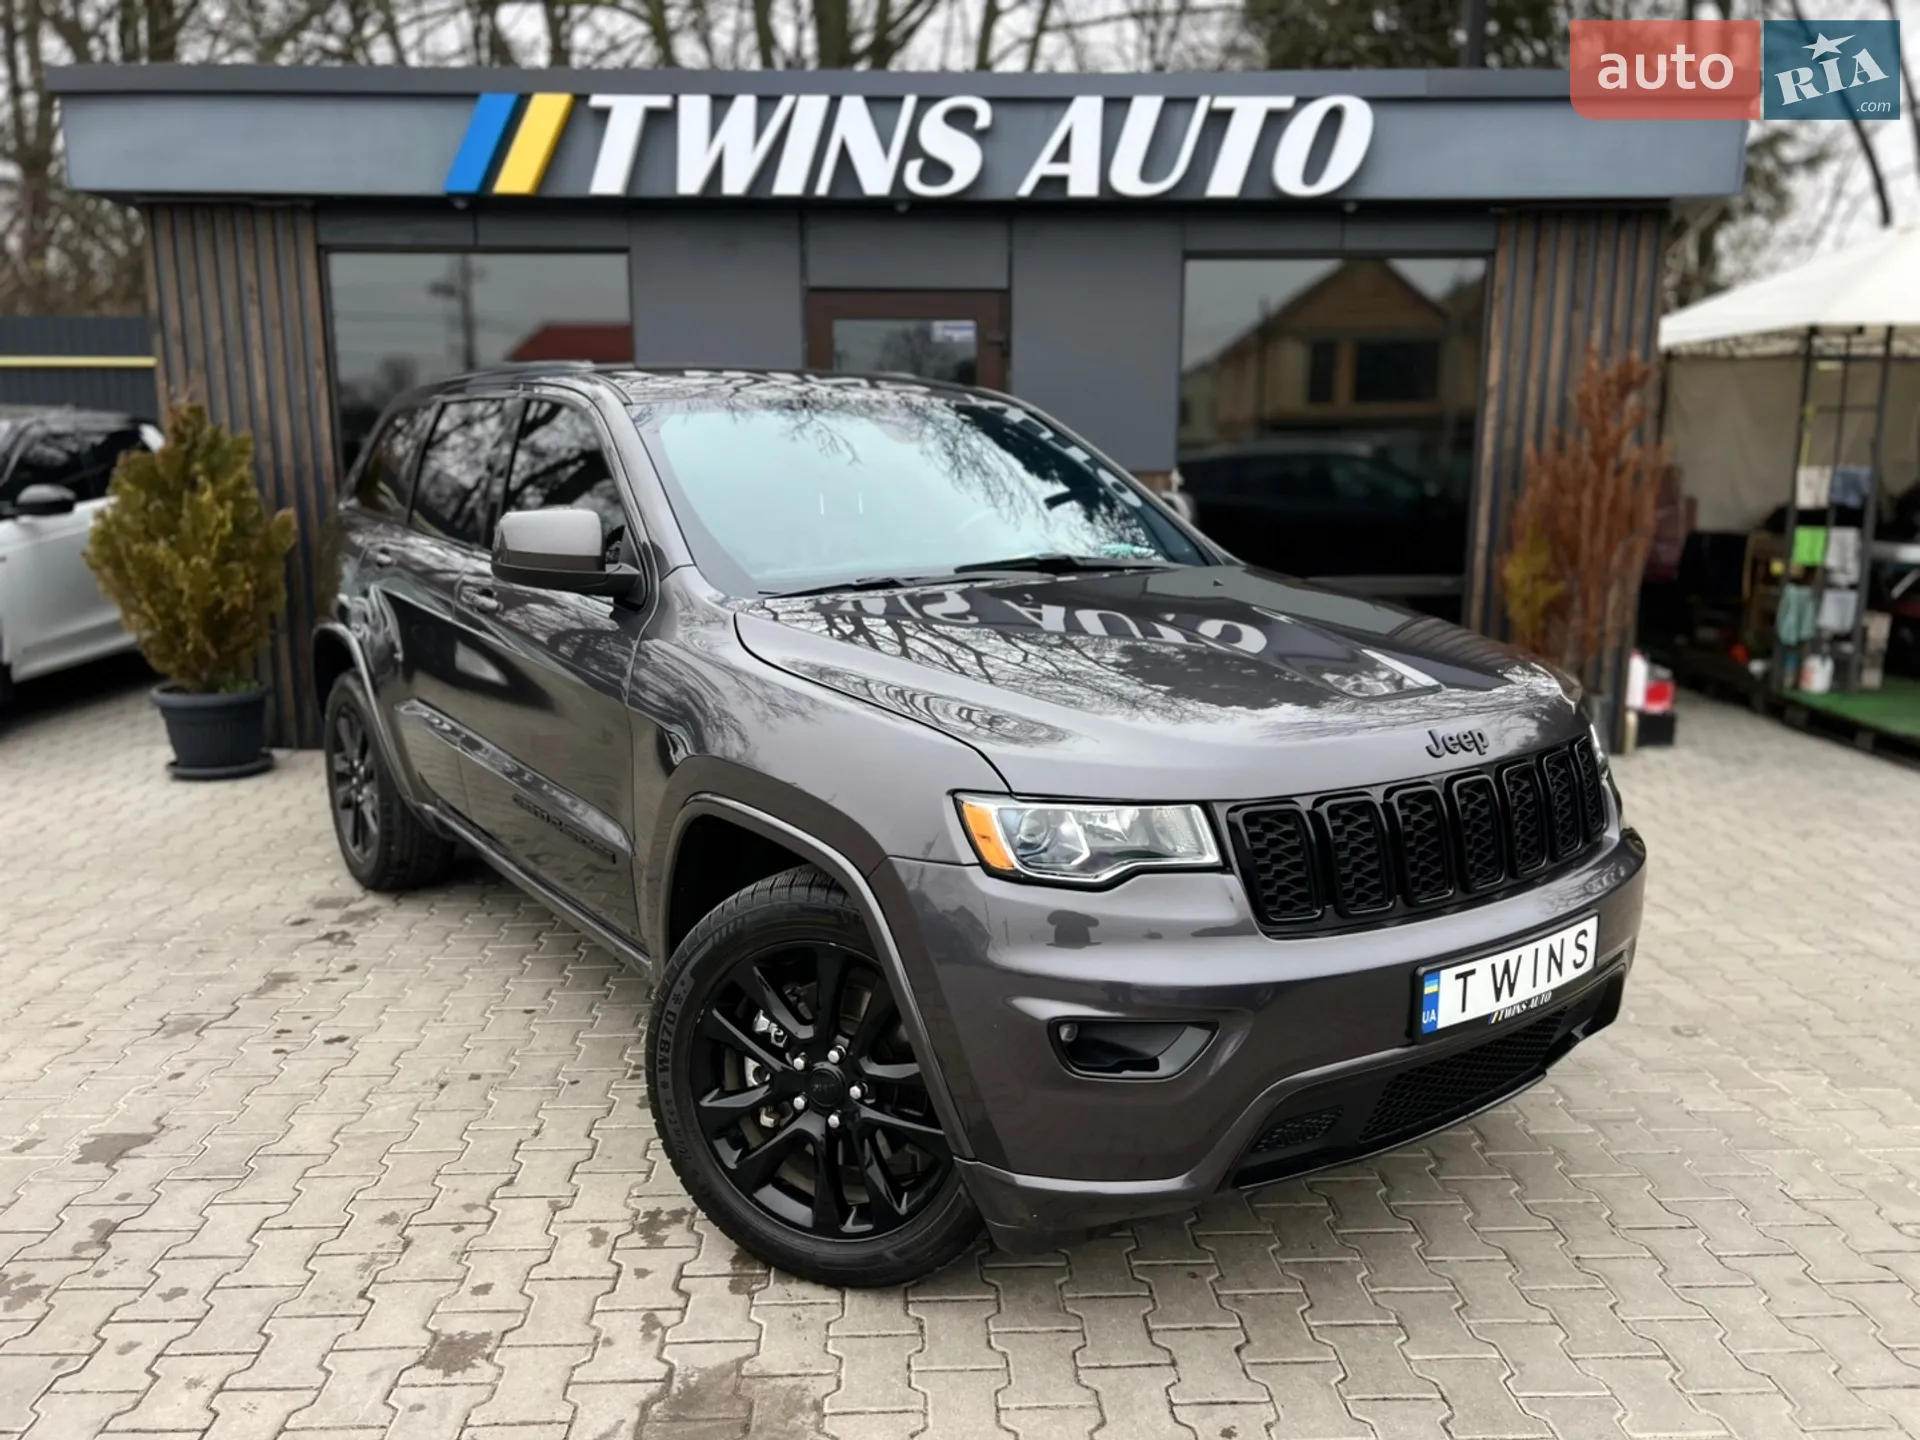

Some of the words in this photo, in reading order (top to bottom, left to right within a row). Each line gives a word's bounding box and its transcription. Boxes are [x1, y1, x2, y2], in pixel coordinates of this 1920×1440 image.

[587, 93, 992, 198] TWINS
[1016, 95, 1375, 198] AUTO
[1425, 728, 1489, 758] Jeep
[1422, 1010, 1436, 1024] UA
